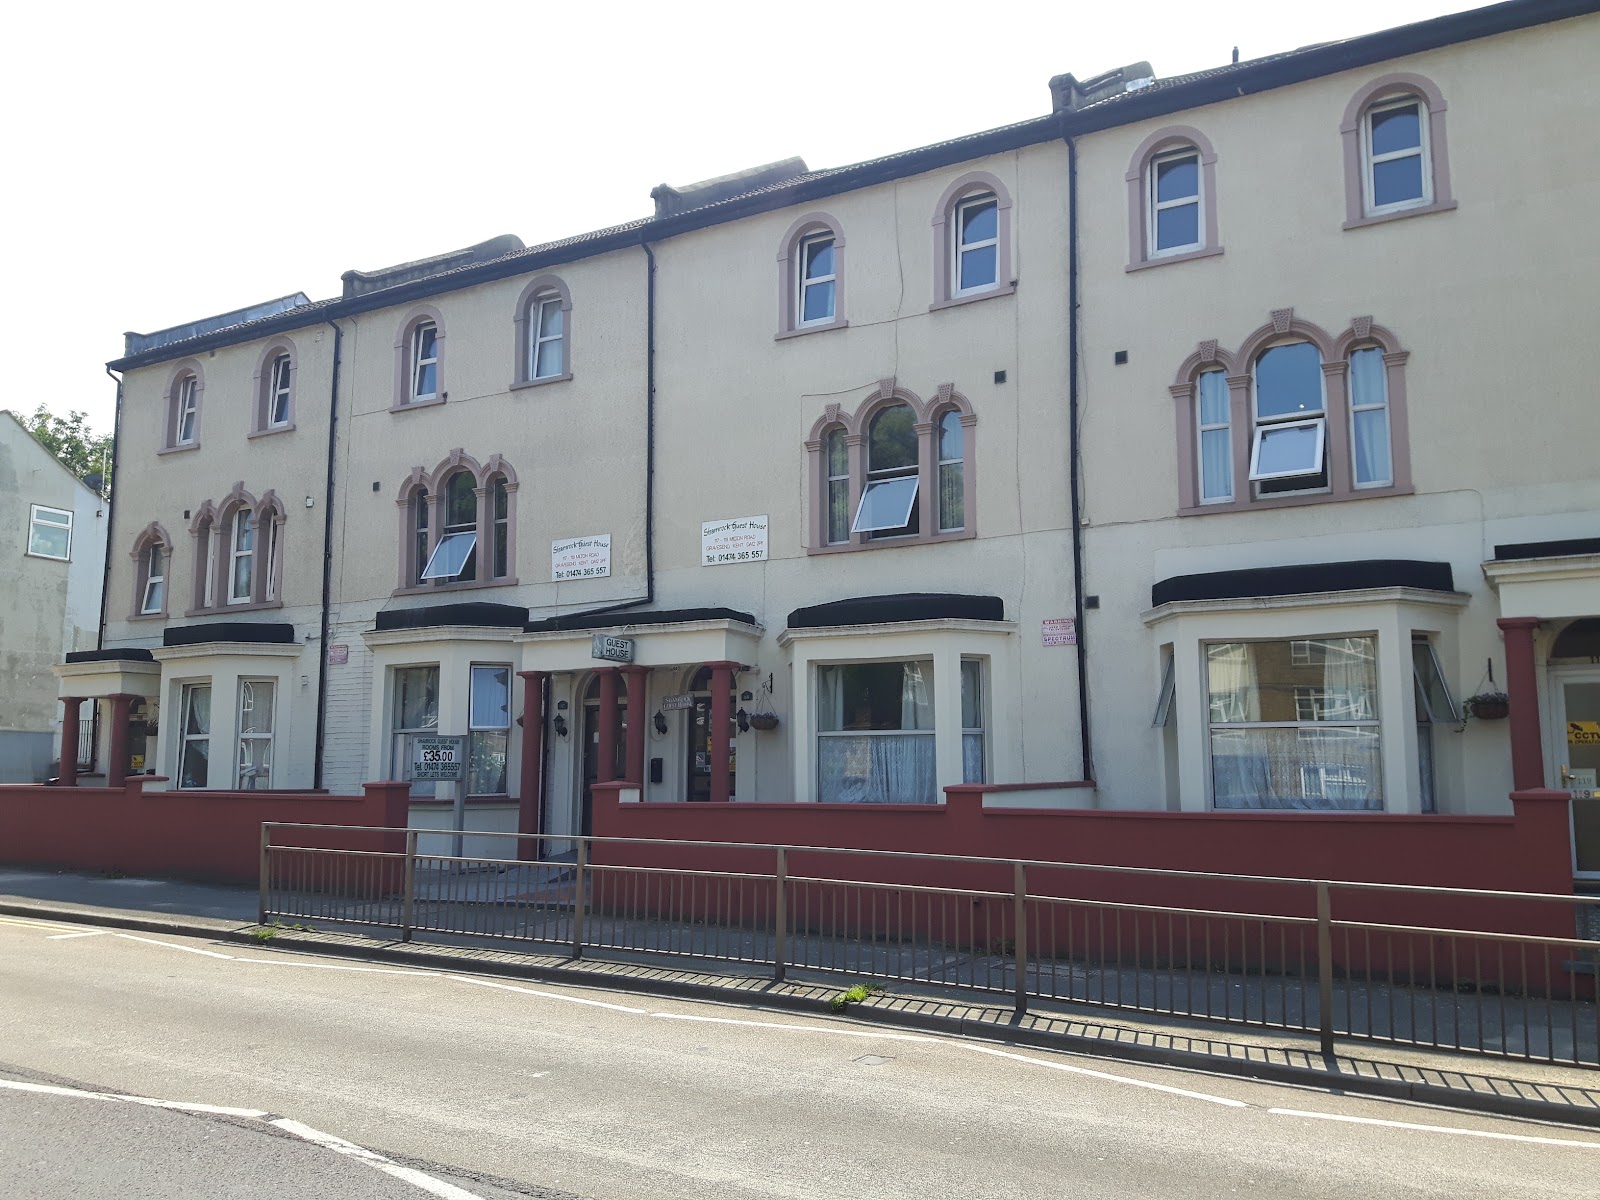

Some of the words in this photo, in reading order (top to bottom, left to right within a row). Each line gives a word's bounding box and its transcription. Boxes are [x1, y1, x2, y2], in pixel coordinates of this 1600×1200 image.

[703, 523, 730, 537] Shamrock
[731, 520, 748, 531] Guest
[749, 520, 767, 530] House
[553, 541, 578, 554] Shamrock
[578, 540, 592, 549] Guest
[594, 540, 609, 548] House
[718, 552, 736, 562] 01474
[737, 551, 750, 560] 365
[751, 550, 763, 559] 557
[566, 568, 582, 578] 01474
[583, 567, 595, 576] 365
[595, 566, 607, 575] 557
[606, 638, 629, 649] GUEST
[605, 647, 629, 659] HOUSE
[423, 750, 453, 762] £35.00
[424, 762, 439, 771] 01474
[440, 762, 461, 771] 365557
